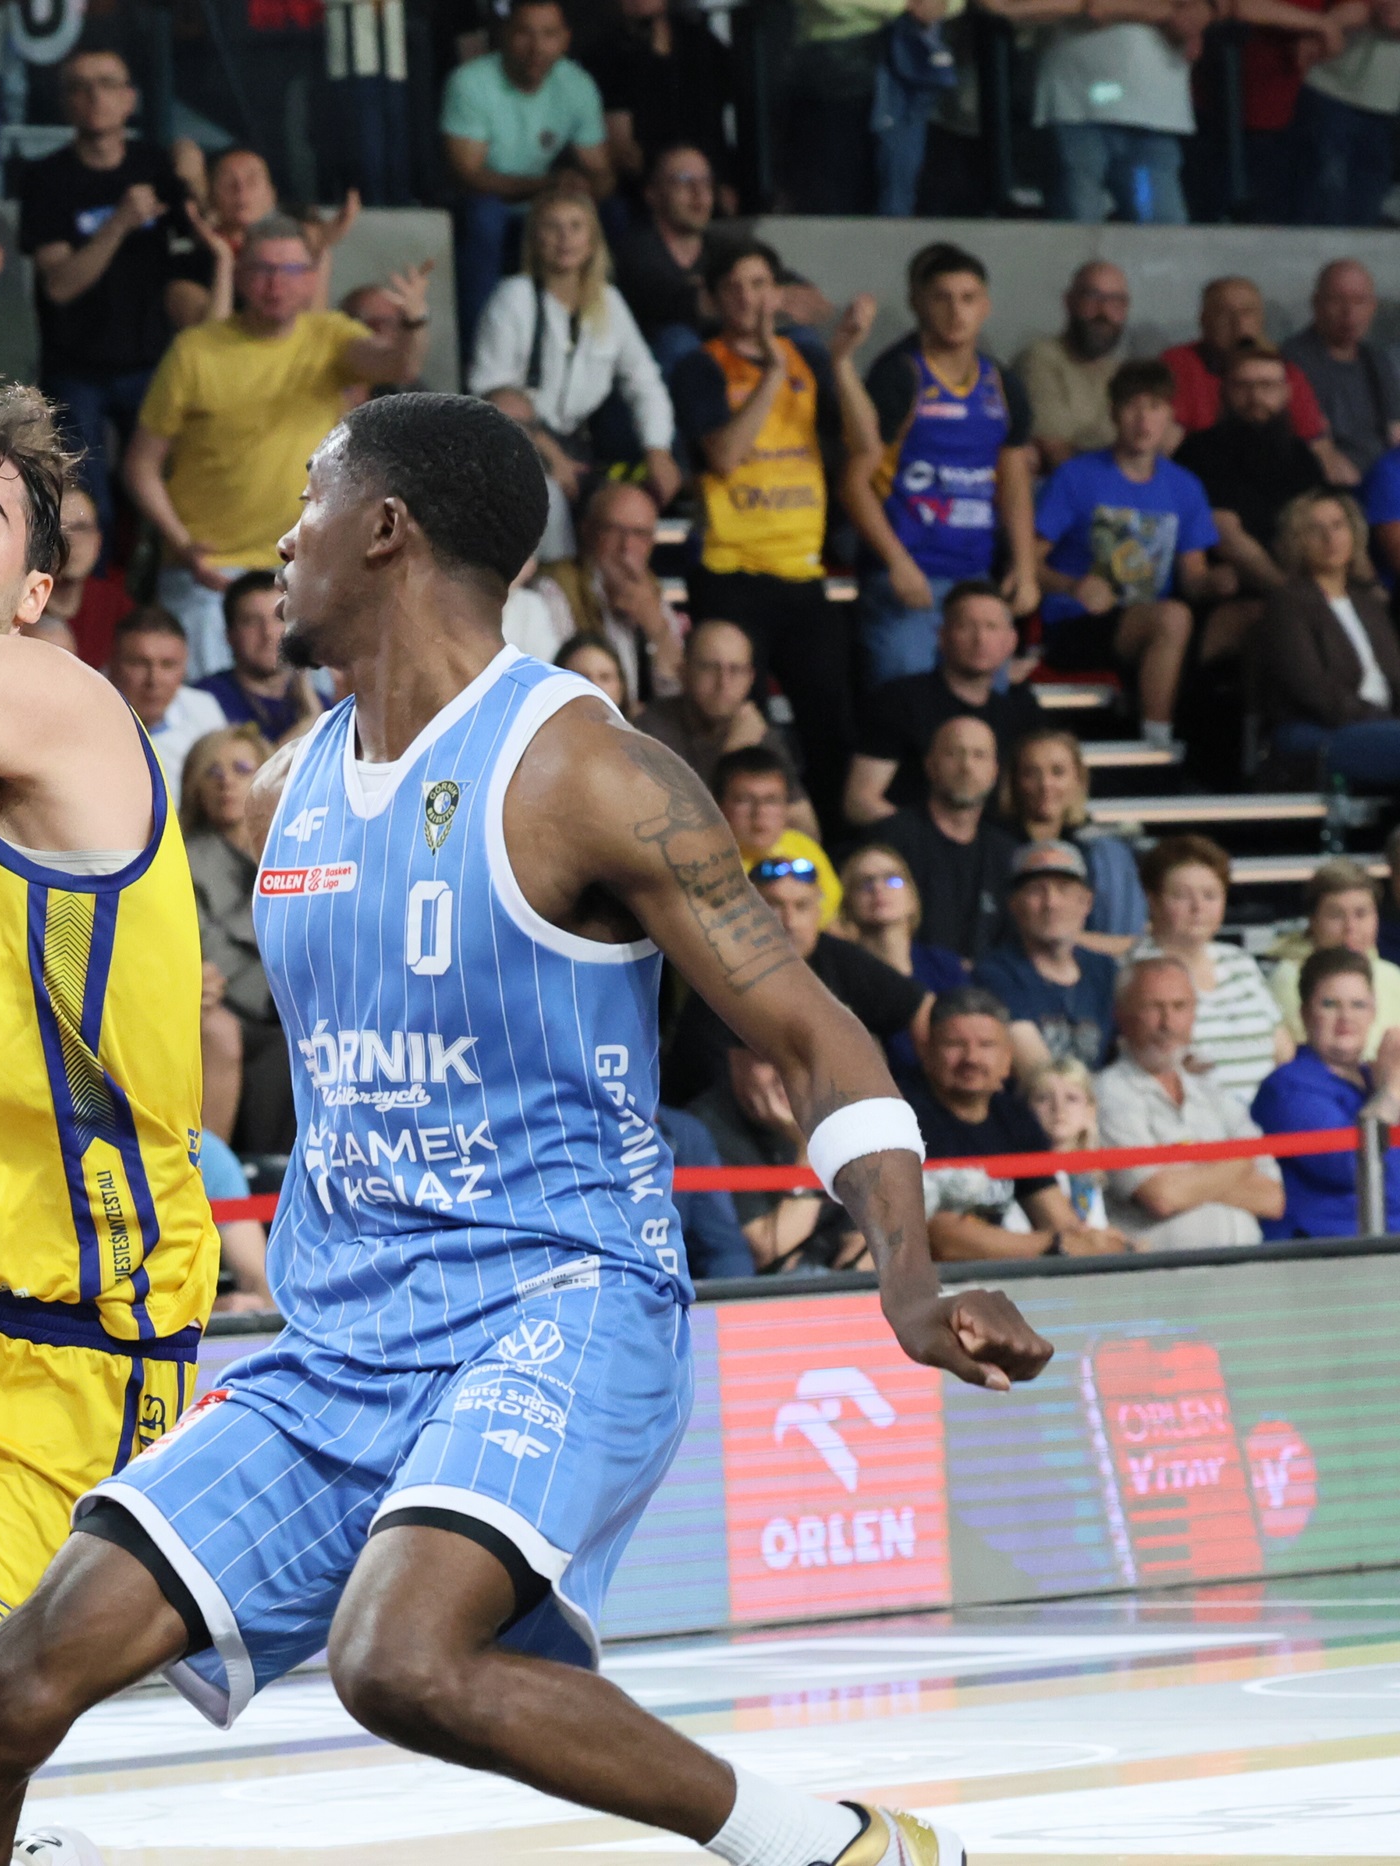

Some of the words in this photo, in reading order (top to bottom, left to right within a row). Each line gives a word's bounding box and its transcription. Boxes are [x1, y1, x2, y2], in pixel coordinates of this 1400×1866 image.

[284, 806, 330, 842] 4F
[263, 874, 304, 891] ORLEN
[325, 866, 352, 877] Basket
[322, 879, 339, 890] Liga
[406, 880, 454, 976] 0
[481, 1429, 551, 1459] 4F
[761, 1505, 916, 1570] ORLEN
